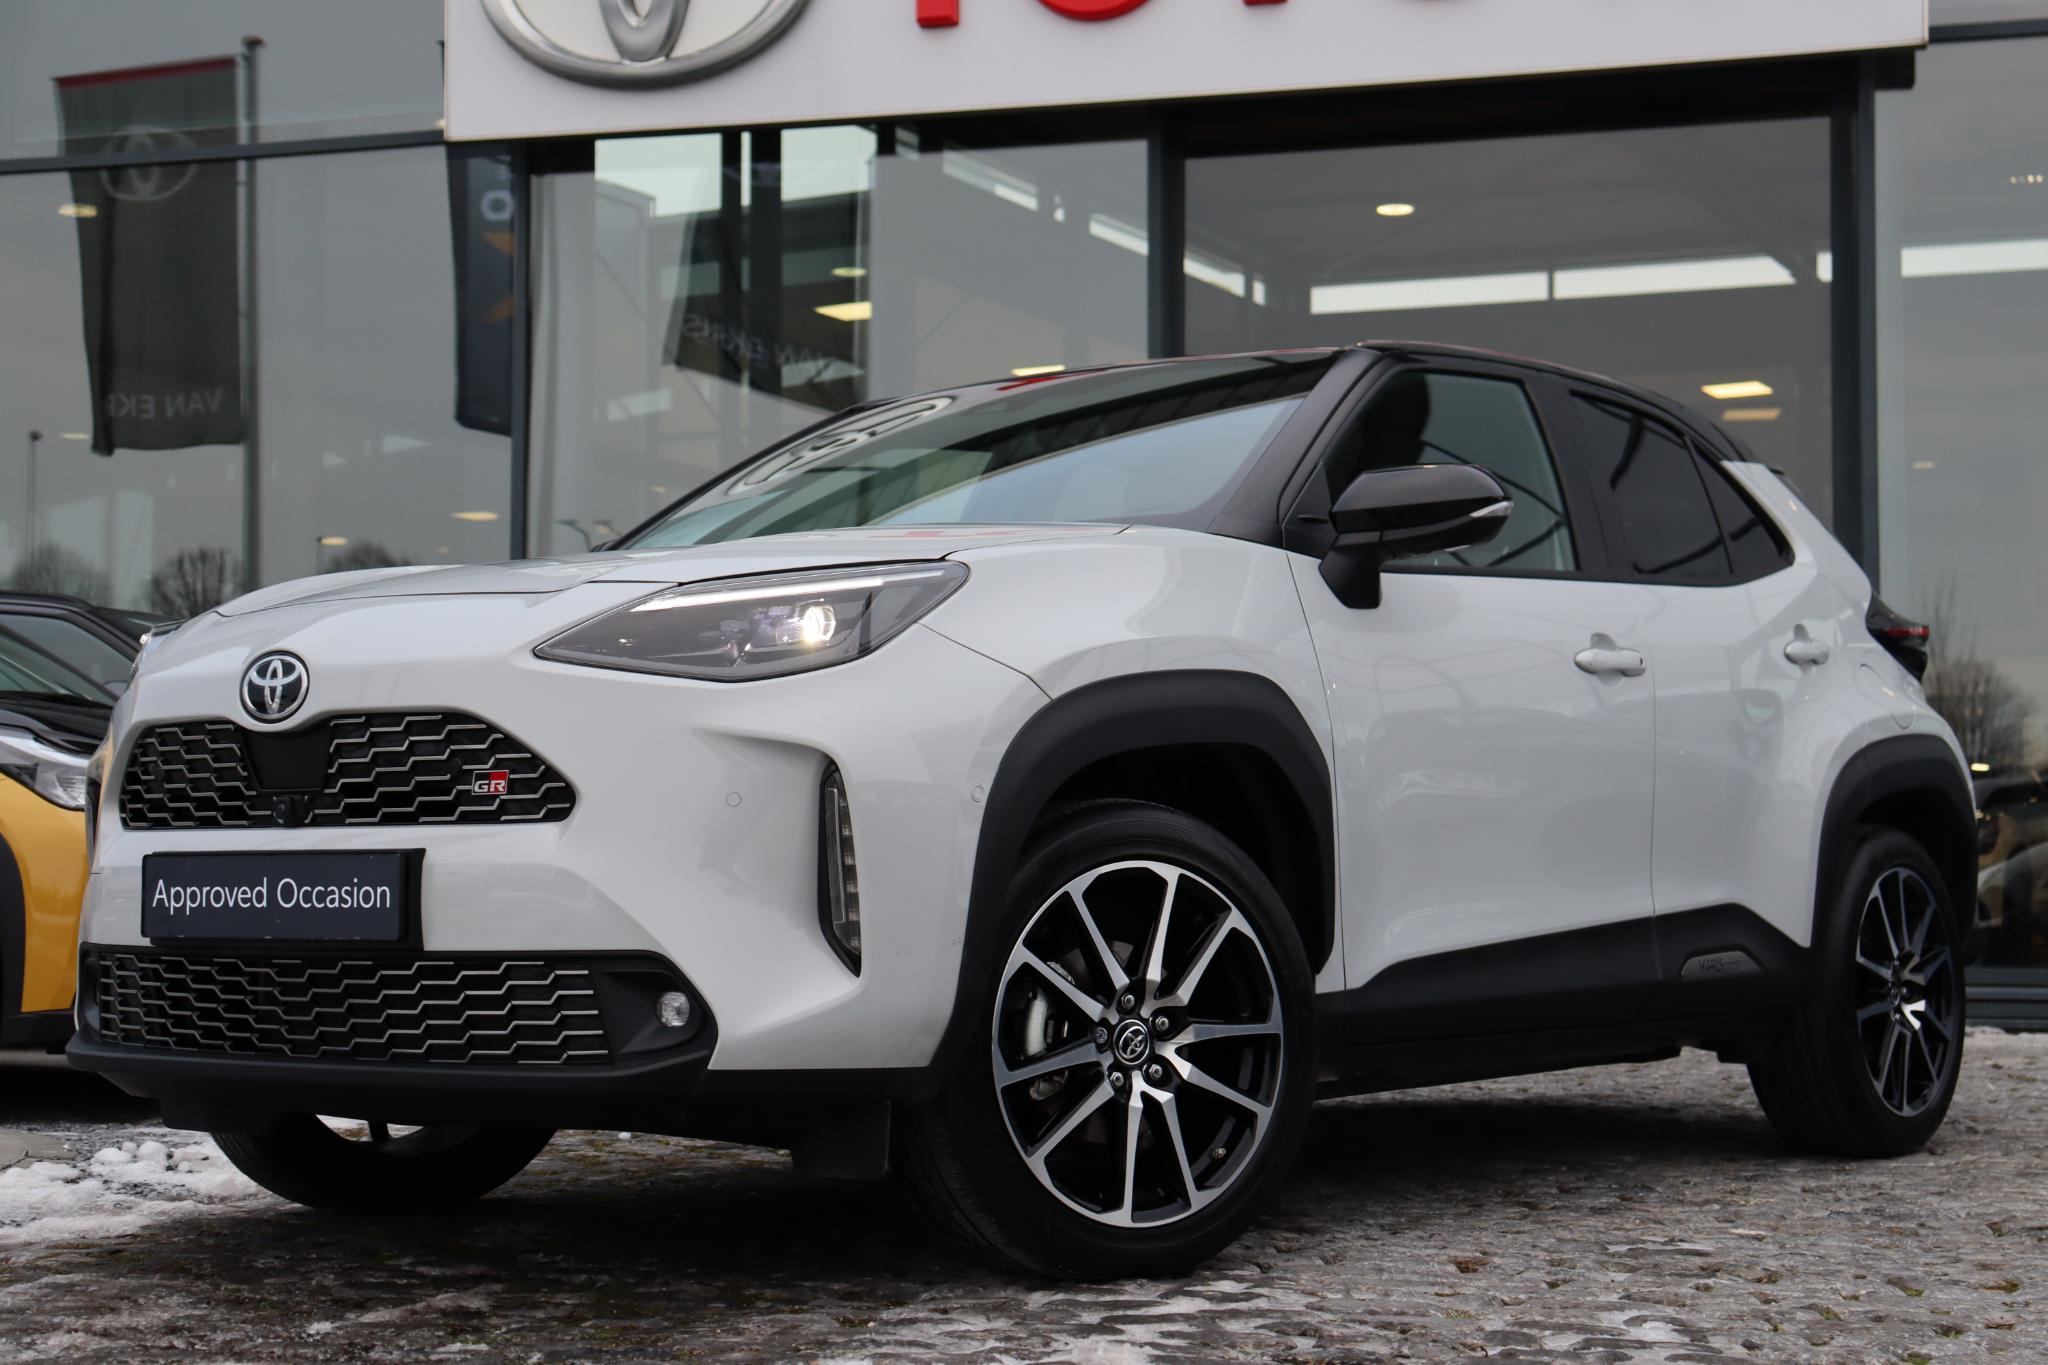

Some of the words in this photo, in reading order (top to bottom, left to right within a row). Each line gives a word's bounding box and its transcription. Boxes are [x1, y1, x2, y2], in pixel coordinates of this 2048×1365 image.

[474, 780, 506, 792] GR
[152, 877, 267, 915] Approved
[277, 878, 390, 908] Occasion
